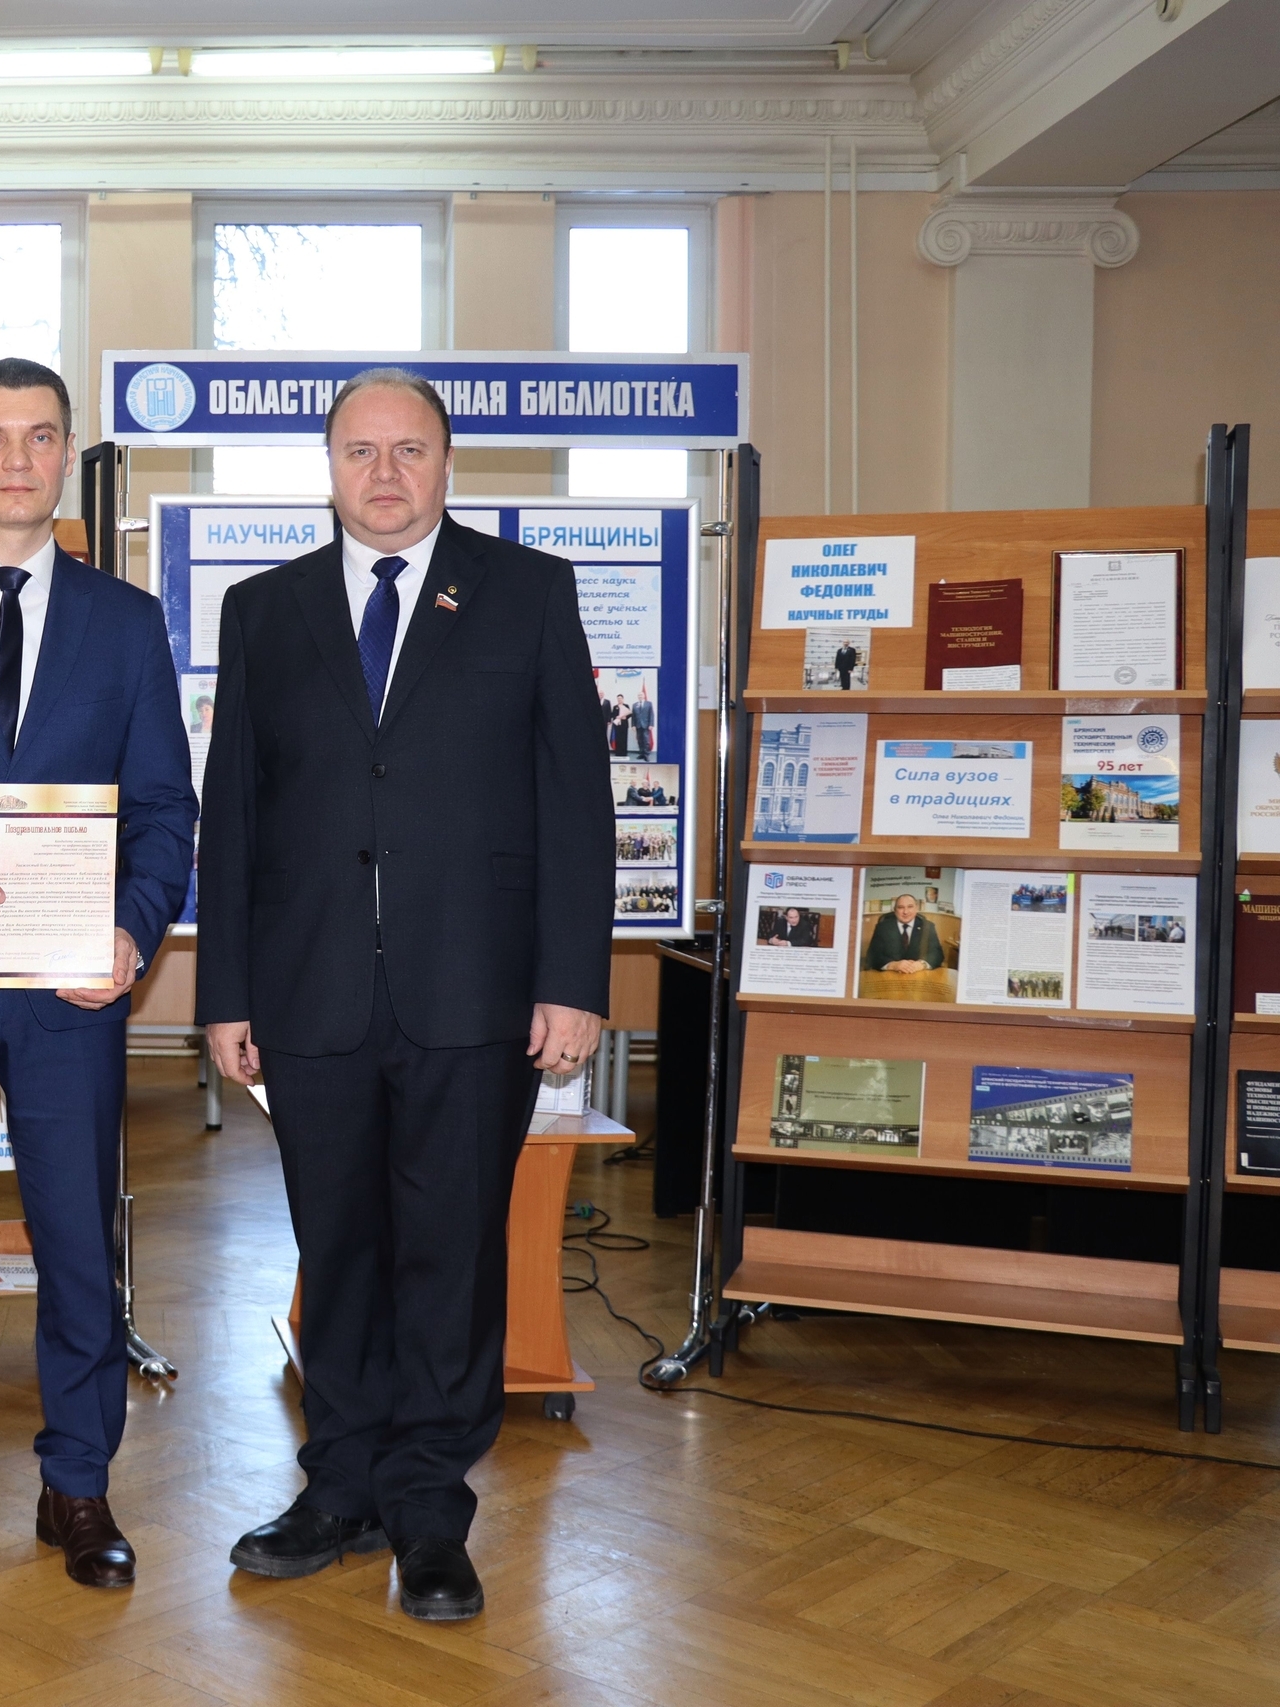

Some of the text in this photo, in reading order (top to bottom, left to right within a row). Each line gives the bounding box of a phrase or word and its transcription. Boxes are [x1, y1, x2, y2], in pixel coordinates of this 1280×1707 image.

[427, 380, 507, 416] ЧНАЯ
[520, 381, 695, 417] БИБЛИОТЕКА
[207, 524, 315, 544] НАУЧНАЯ
[522, 526, 659, 550] БРЯНЩИНЫ
[822, 544, 858, 557] ОЛЕГ
[791, 563, 888, 578] НИКОЛАЕВИЧ
[602, 577, 636, 586] науки
[800, 584, 876, 599] ФЕДОНИН.
[607, 604, 648, 614] учёных
[788, 609, 889, 621] НАУЧНЫЕ ТРУДЫ
[1097, 761, 1143, 771] 95 лет
[895, 768, 940, 781] Сила
[945, 771, 999, 784] вузов
[890, 794, 899, 804] в
[5, 824, 62, 835] Поздравительное
